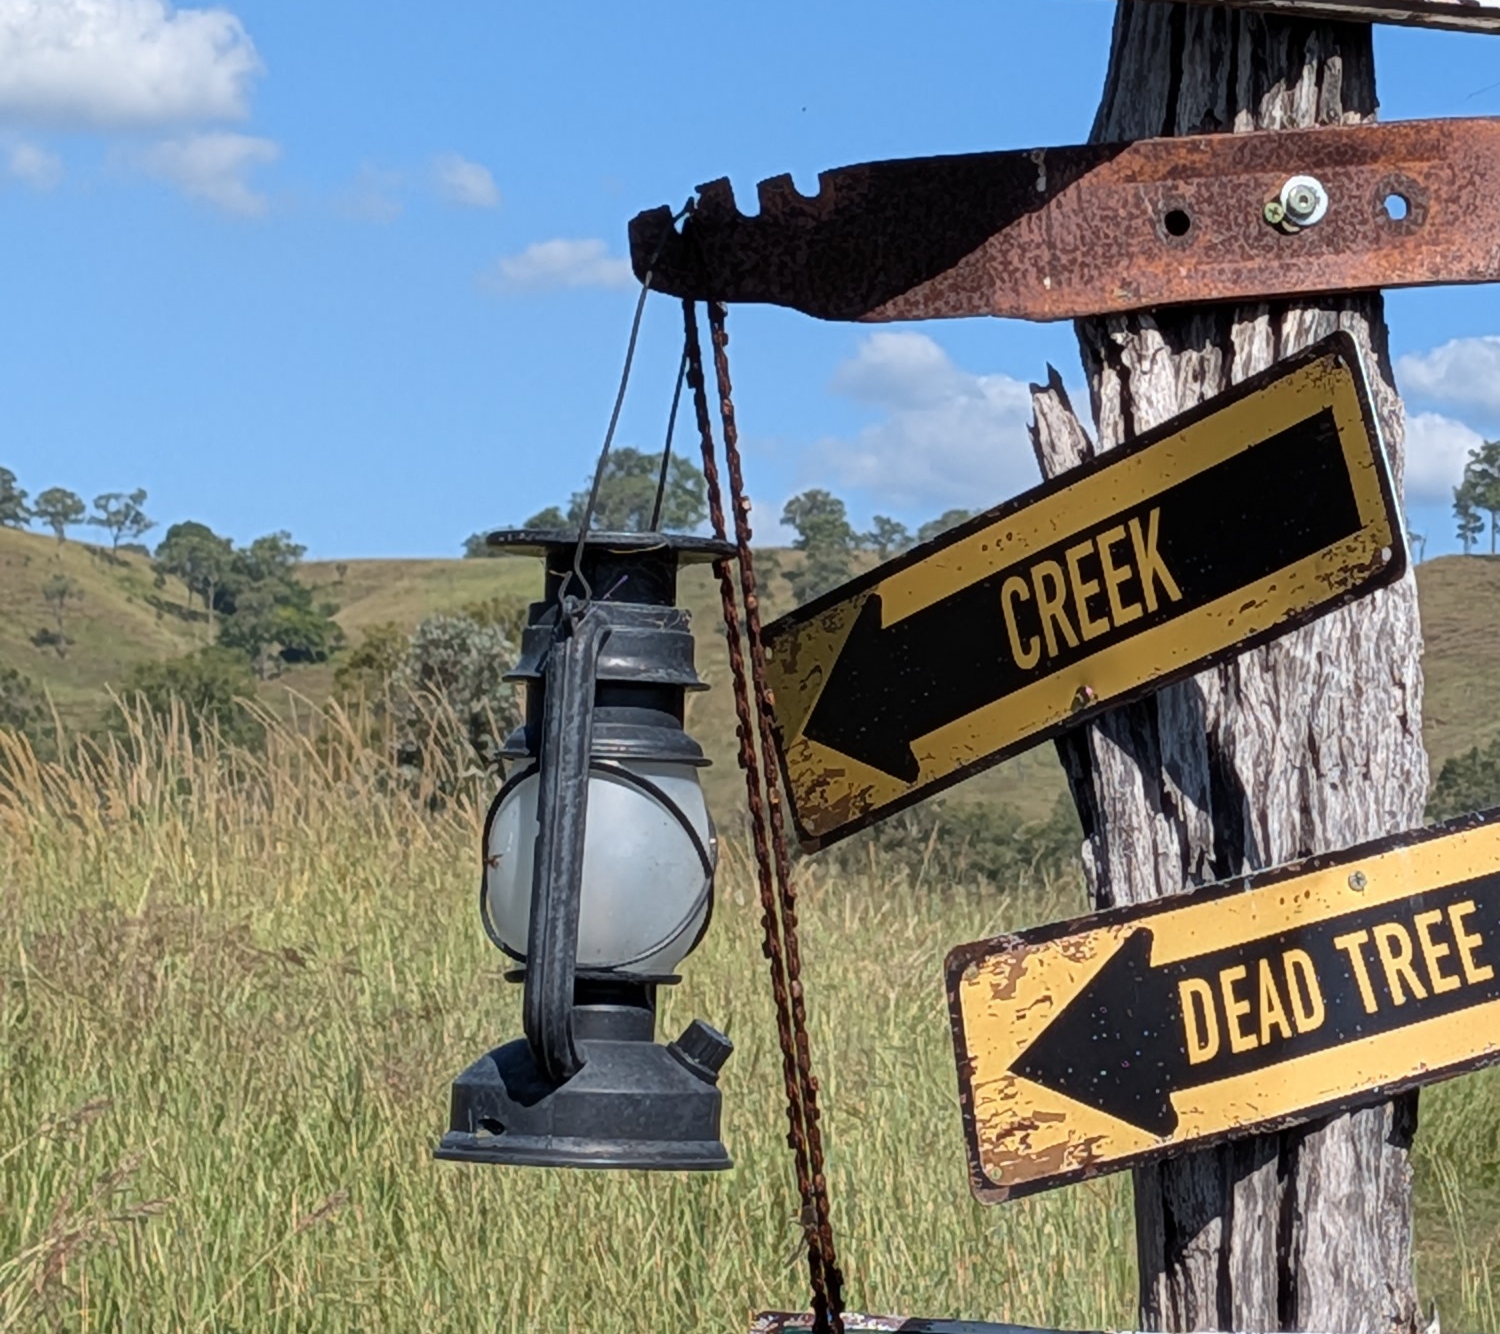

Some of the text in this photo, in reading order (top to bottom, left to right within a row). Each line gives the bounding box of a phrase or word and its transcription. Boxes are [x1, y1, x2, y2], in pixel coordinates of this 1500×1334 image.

[1001, 507, 1182, 669] CREEK
[1178, 953, 1326, 1065] DEAD
[1335, 900, 1494, 1014] TREE
